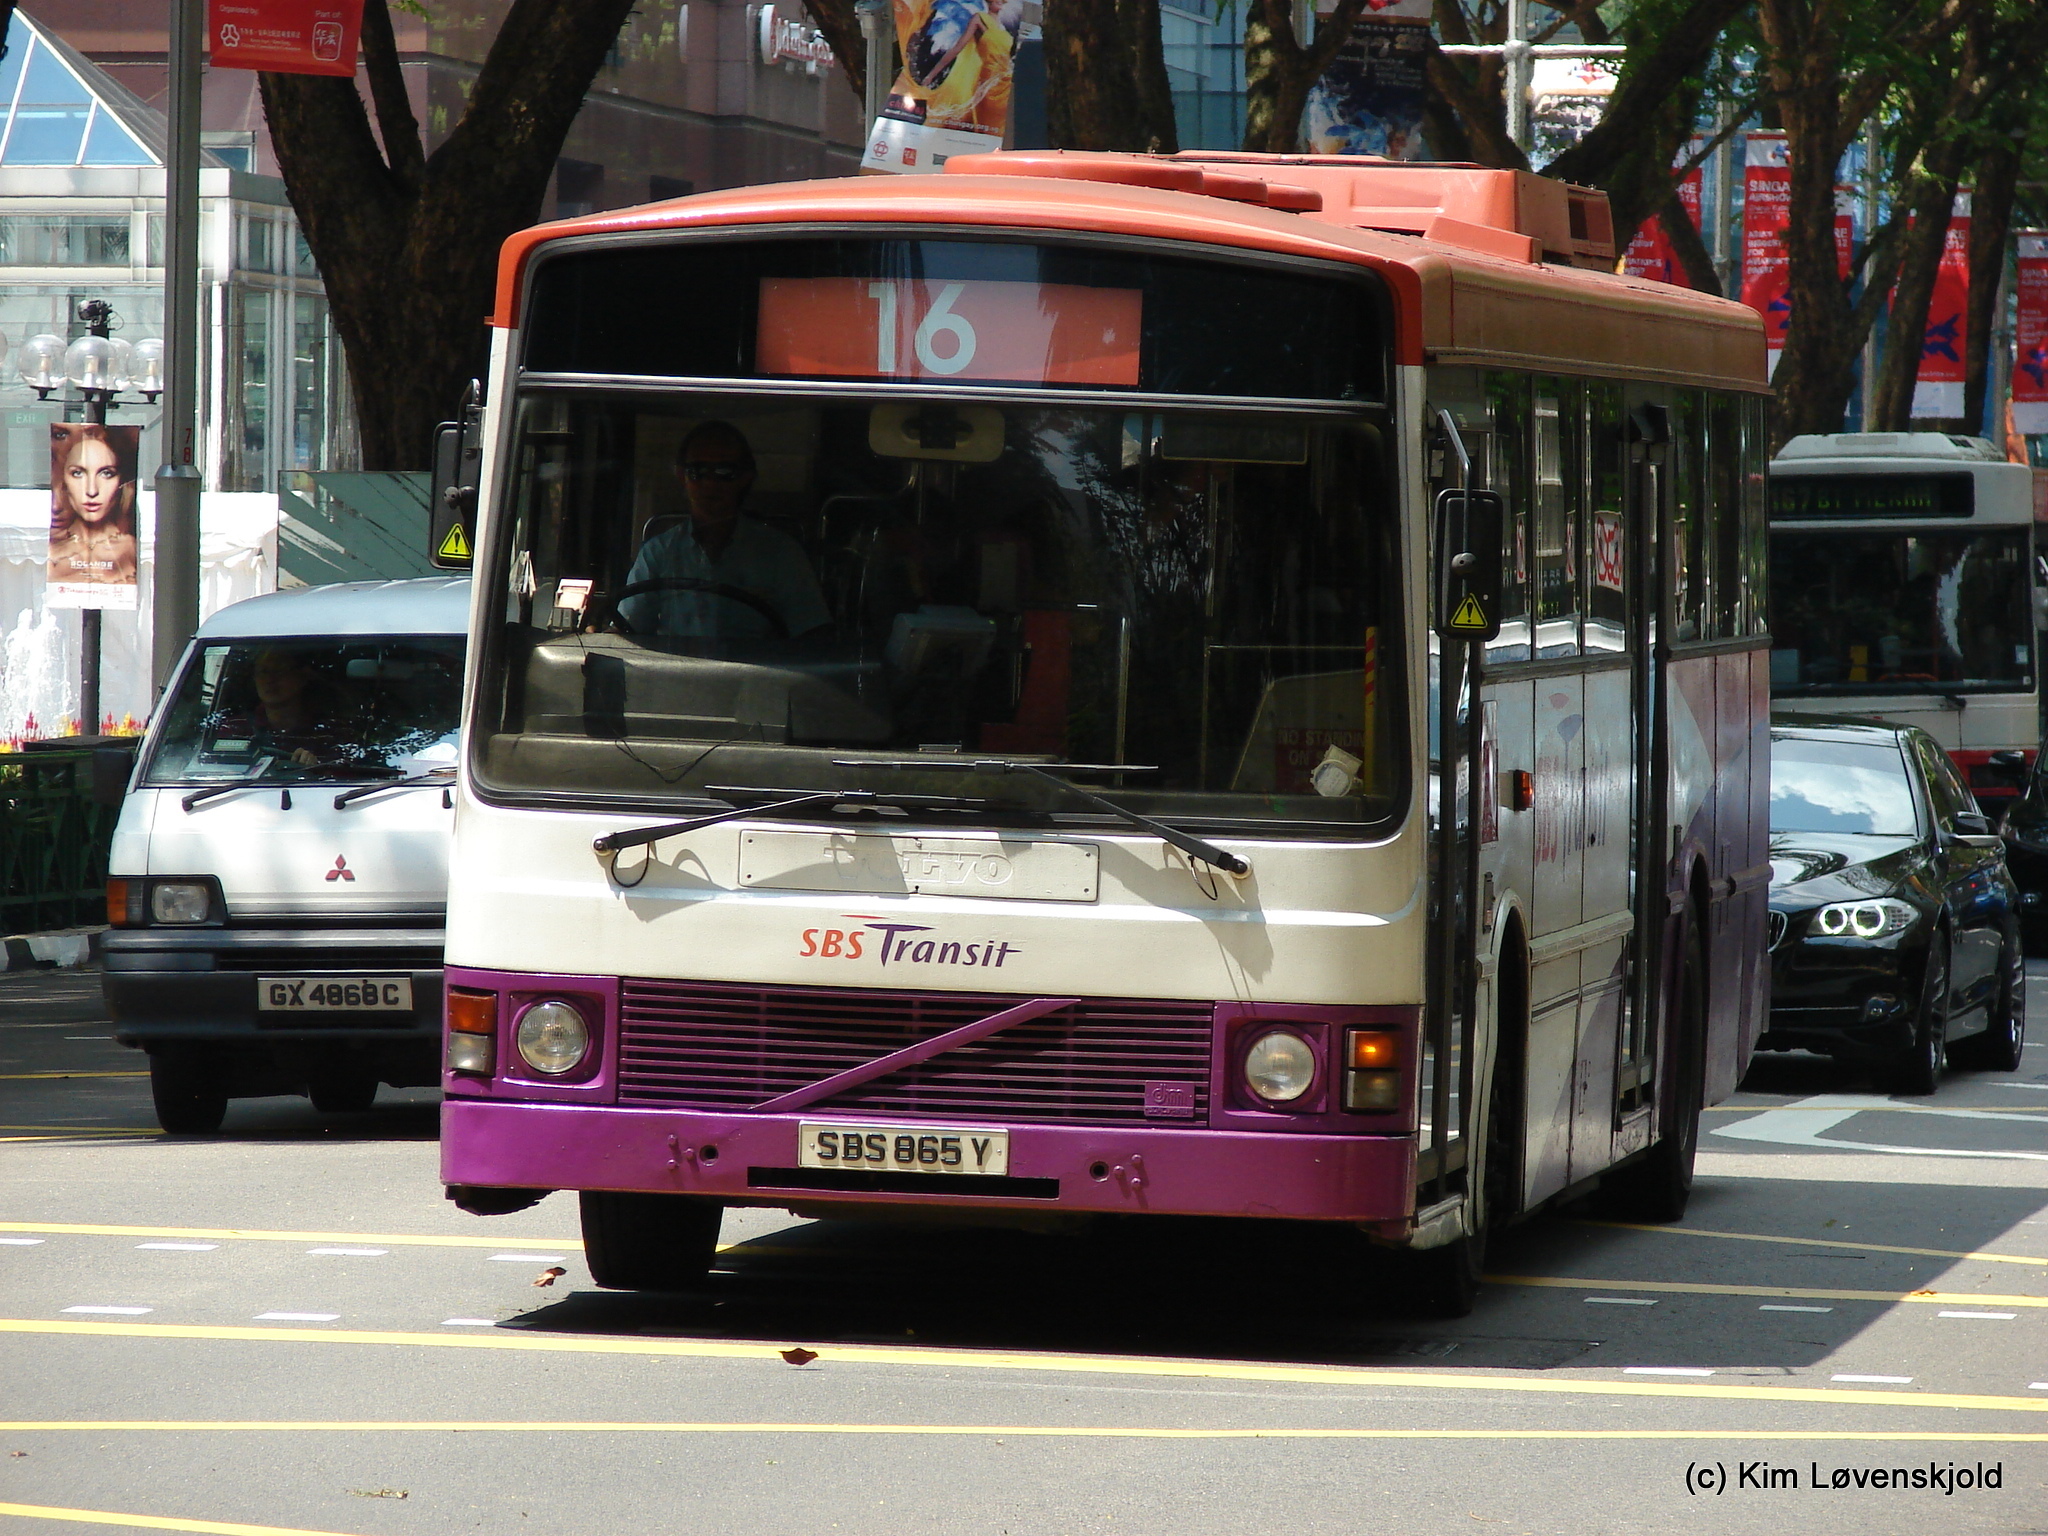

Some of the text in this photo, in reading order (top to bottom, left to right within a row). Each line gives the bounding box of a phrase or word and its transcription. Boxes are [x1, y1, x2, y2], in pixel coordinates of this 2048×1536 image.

[315, 10, 331, 18] Part
[868, 281, 977, 375] 16
[15, 412, 36, 424] EXIT
[799, 923, 1023, 967] SBS Transit
[269, 982, 400, 1006] GX 4868 C
[816, 1130, 992, 1167] SBS 865 Y
